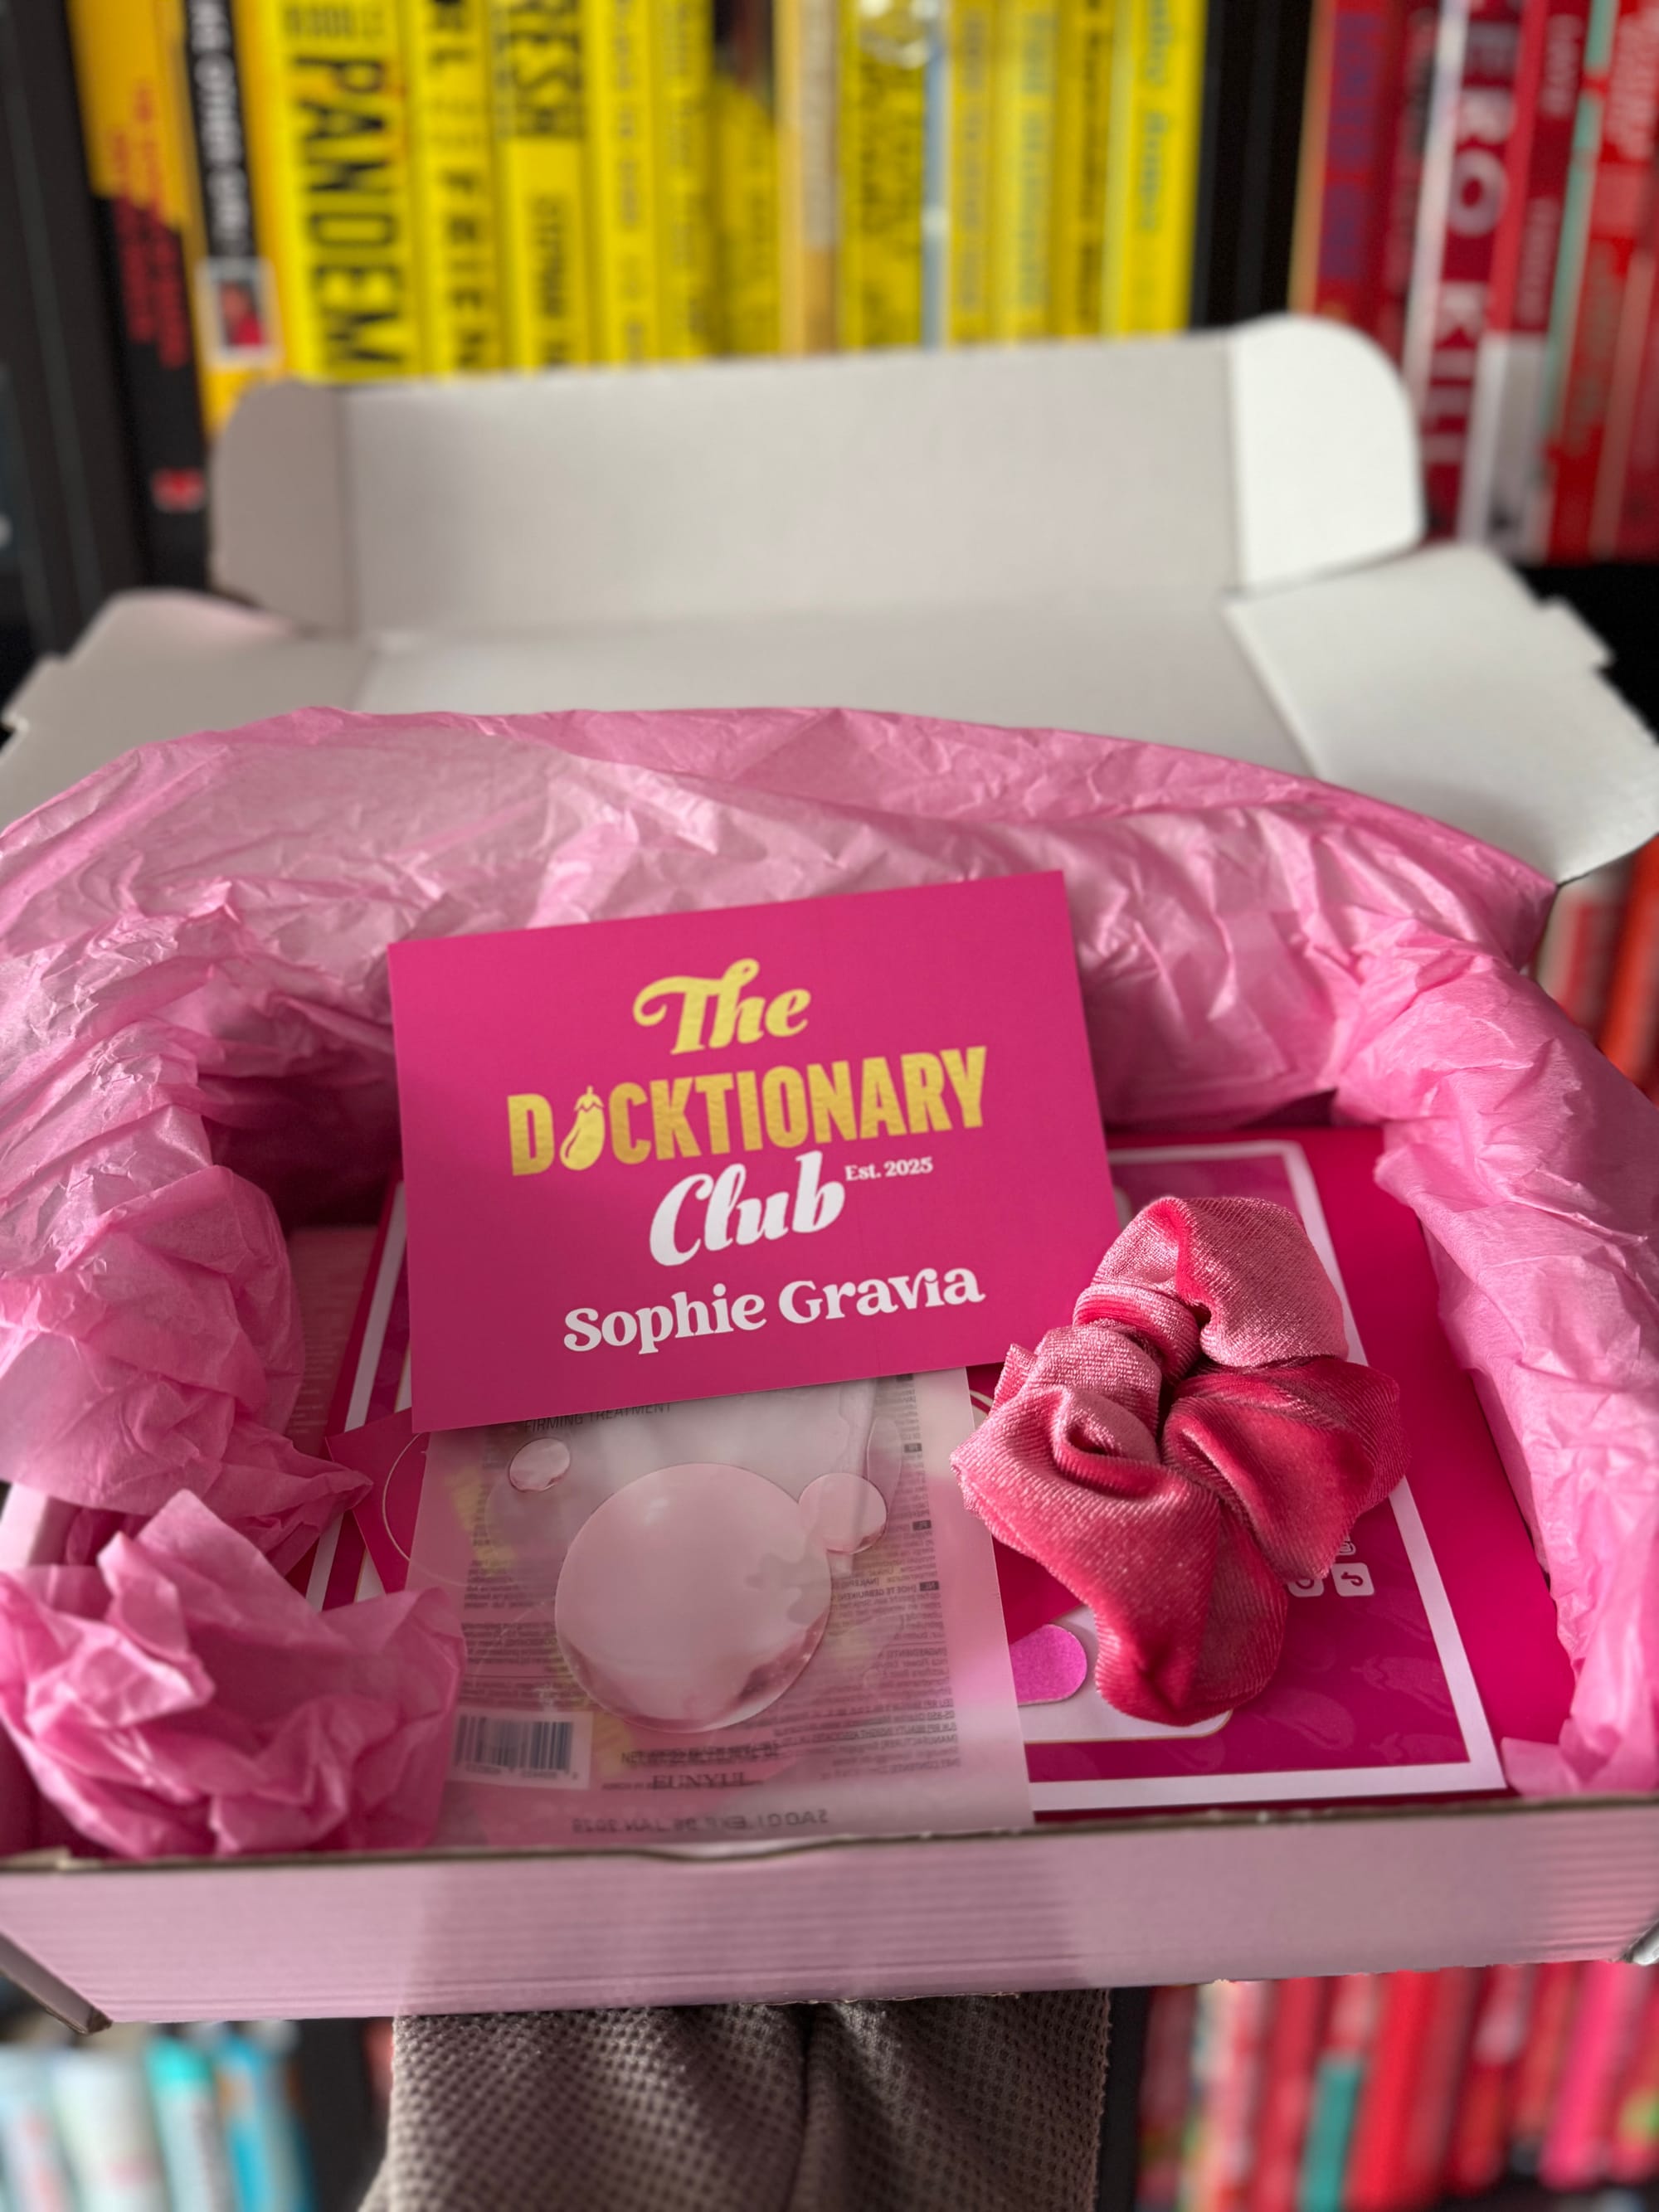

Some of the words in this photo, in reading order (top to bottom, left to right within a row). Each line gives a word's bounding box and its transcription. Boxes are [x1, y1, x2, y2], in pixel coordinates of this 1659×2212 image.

[632, 958, 811, 1055] The
[649, 1150, 845, 1266] Club
[845, 1163, 881, 1182] Est.
[884, 1156, 934, 1178] 2025
[564, 1283, 767, 1354] Sophie
[778, 1268, 985, 1325] Gravia
